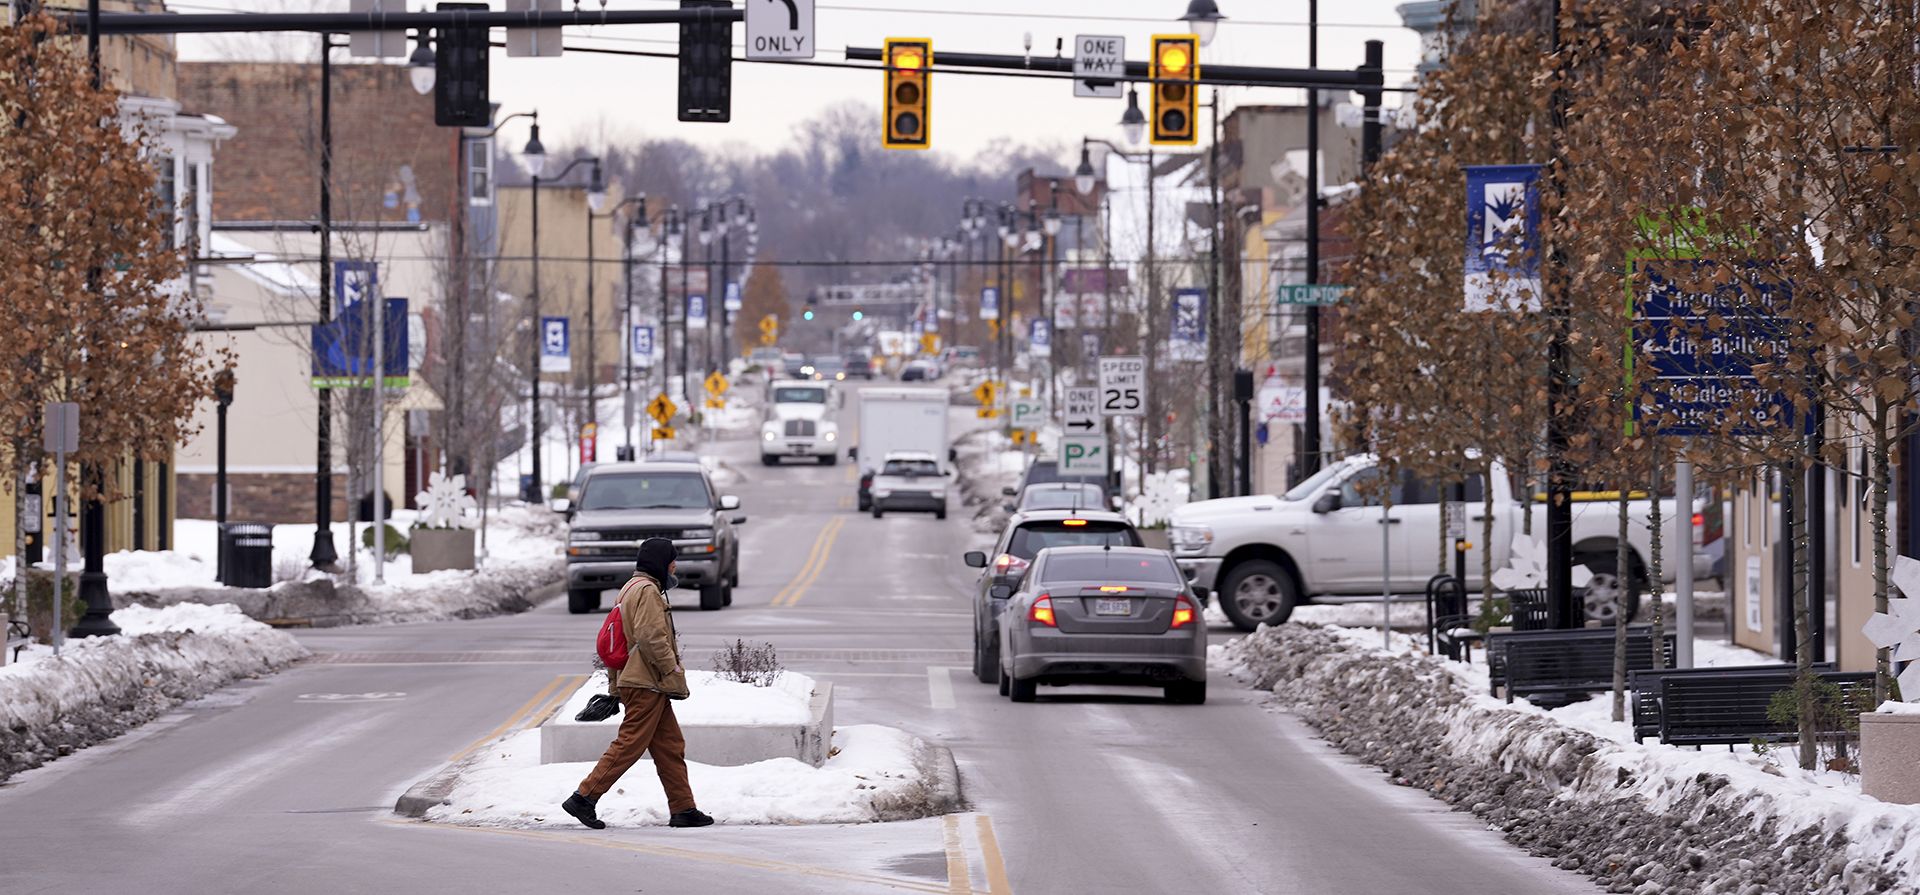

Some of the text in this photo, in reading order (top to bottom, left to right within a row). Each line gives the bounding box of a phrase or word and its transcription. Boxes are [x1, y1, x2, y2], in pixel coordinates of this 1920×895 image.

[755, 36, 804, 51] ONLY
[1084, 40, 1116, 54] ONE
[1082, 57, 1116, 72] WAY
[1280, 287, 1290, 303] N
[1711, 336, 1789, 359] Buildng
[1102, 362, 1141, 372] SPEED
[1106, 375, 1136, 385] LIMIT
[1069, 391, 1096, 401] ONE
[1105, 389, 1140, 409] 25
[1069, 405, 1096, 414] WAY
[1065, 444, 1085, 468] P
